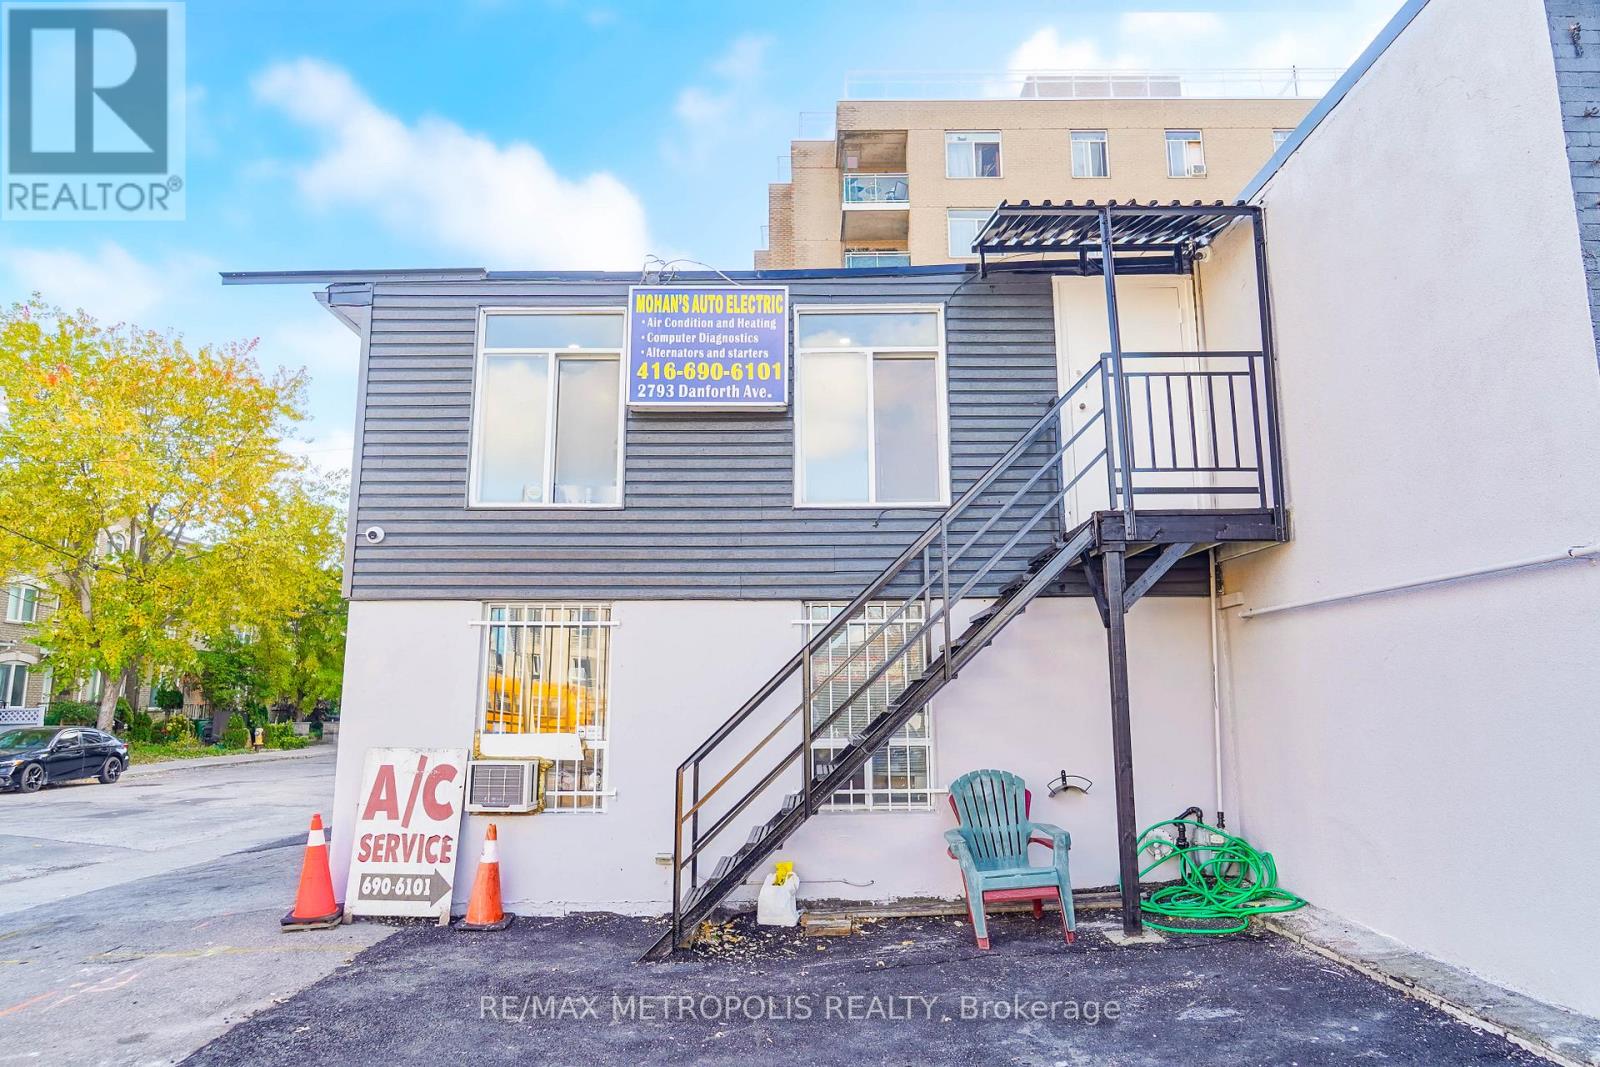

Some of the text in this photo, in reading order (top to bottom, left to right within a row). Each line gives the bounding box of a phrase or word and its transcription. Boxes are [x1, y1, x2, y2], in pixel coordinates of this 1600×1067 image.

[636, 294, 783, 314] MOHAN'S AUTO ELECTRIC
[647, 318, 776, 330] Air Condition and Heating
[647, 333, 759, 345] Computer Diagnostics
[646, 348, 769, 358] Alternators and starters
[636, 362, 781, 380] 416-690-6101
[638, 384, 772, 398] 2793 Danforth Ave.
[362, 755, 458, 828] A/C
[357, 833, 453, 864] SERVICE
[361, 877, 431, 896] 690-6101
